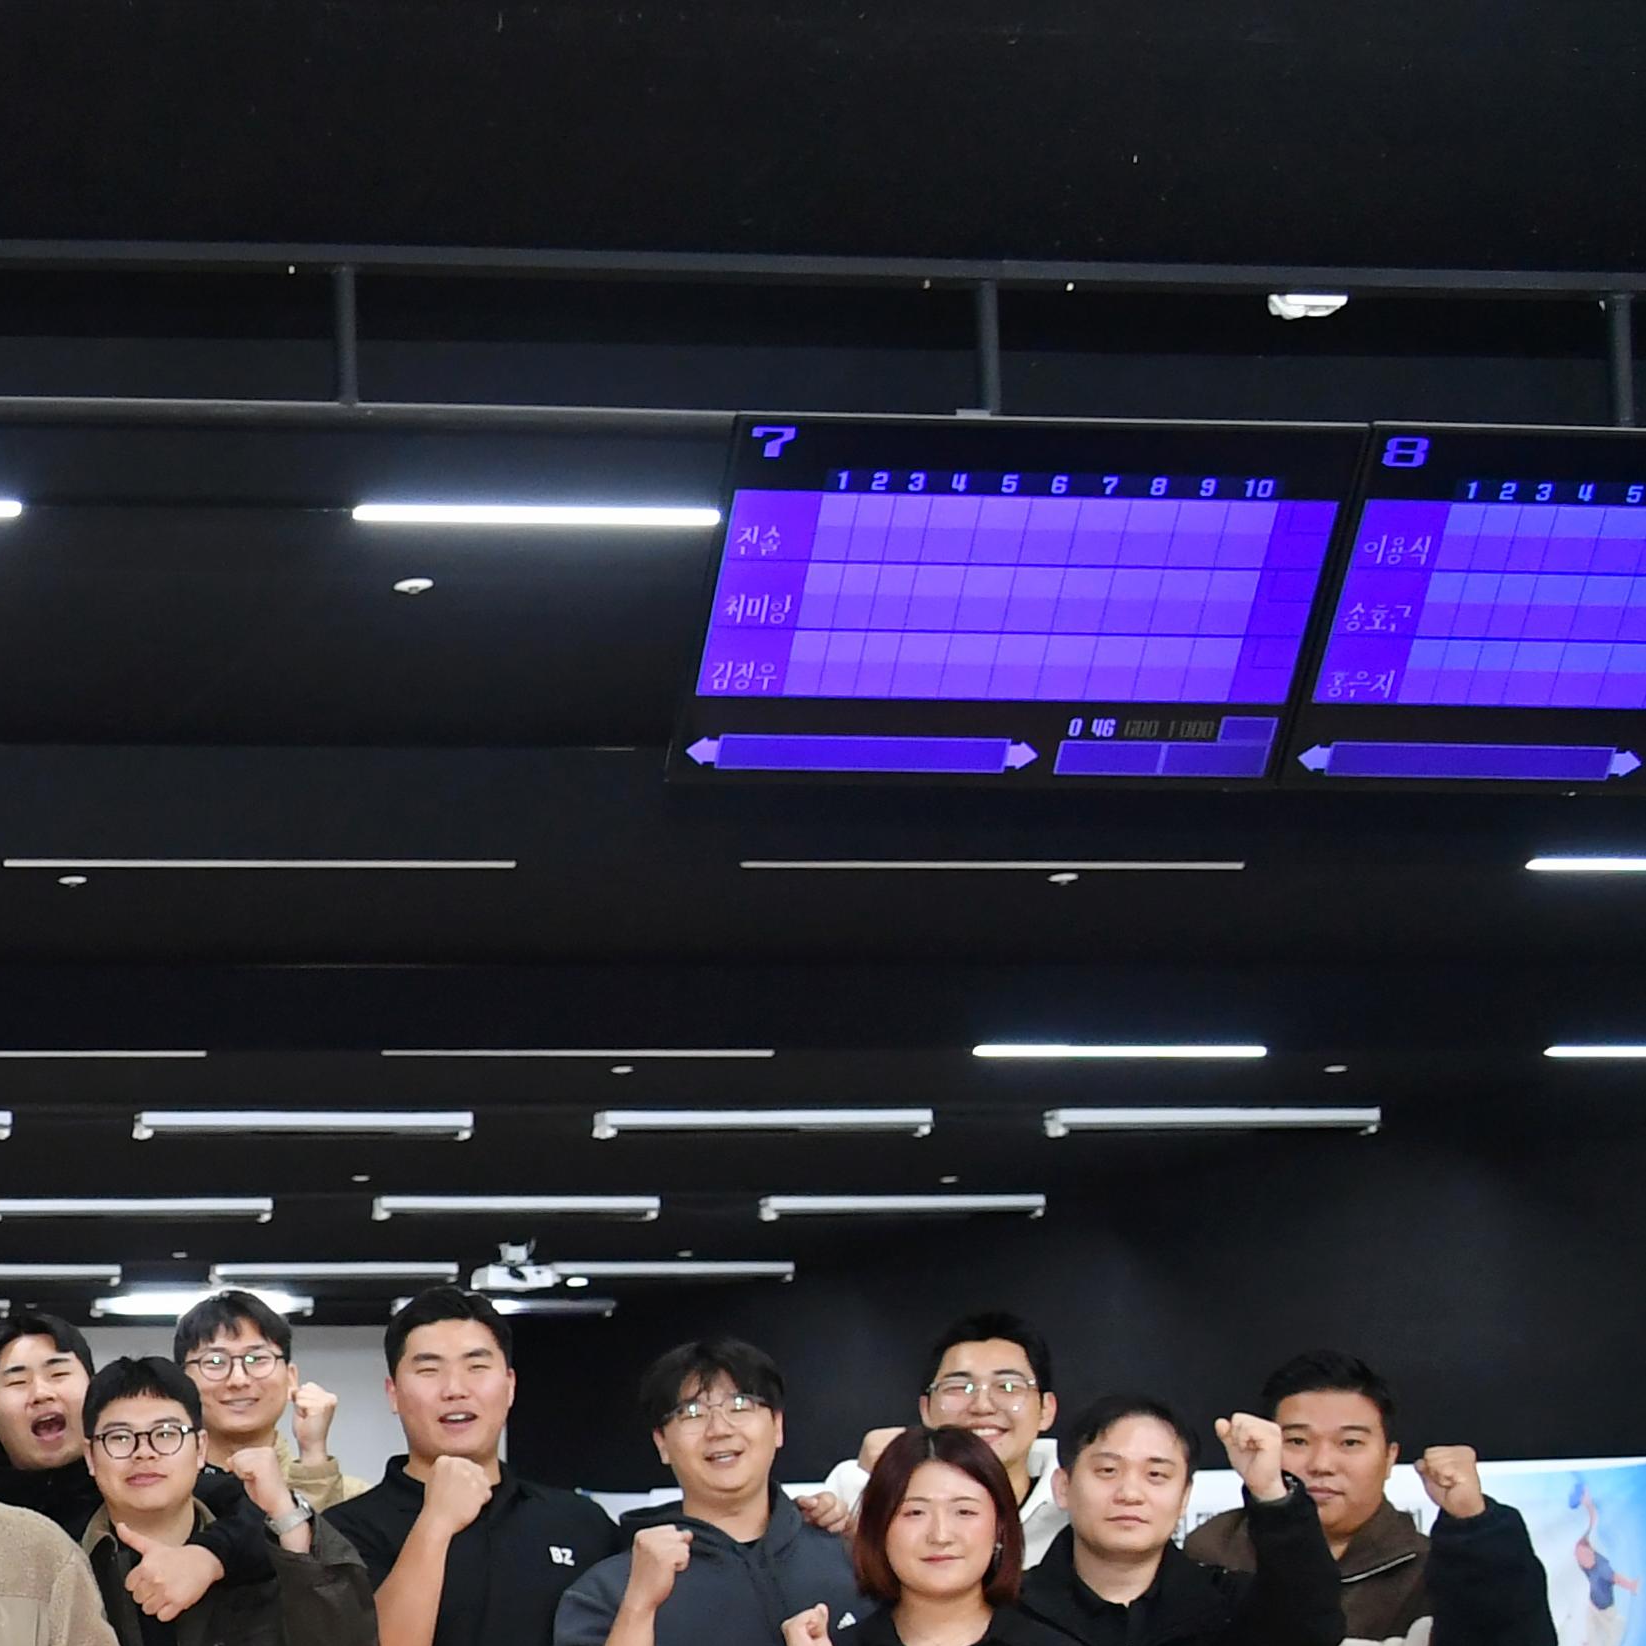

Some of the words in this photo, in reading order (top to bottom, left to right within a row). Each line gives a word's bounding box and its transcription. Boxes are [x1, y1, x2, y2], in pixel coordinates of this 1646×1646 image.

[752, 426, 797, 457] 7
[1382, 437, 1429, 467] 8
[837, 471, 849, 490] 1
[871, 472, 889, 491] 2
[908, 473, 925, 492] 3
[952, 473, 966, 491] 4
[1002, 474, 1017, 492] 5
[1052, 475, 1067, 493] 6
[1103, 476, 1117, 494] 7
[1151, 477, 1166, 495] 8
[1200, 478, 1215, 496] 9
[1246, 479, 1273, 498] 10
[1469, 483, 1476, 499] 1
[1500, 483, 1516, 500] 2
[1536, 484, 1551, 500] 3
[1579, 485, 1592, 501] 4
[1627, 486, 1643, 502] 5
[1364, 535, 1431, 565] 이용식
